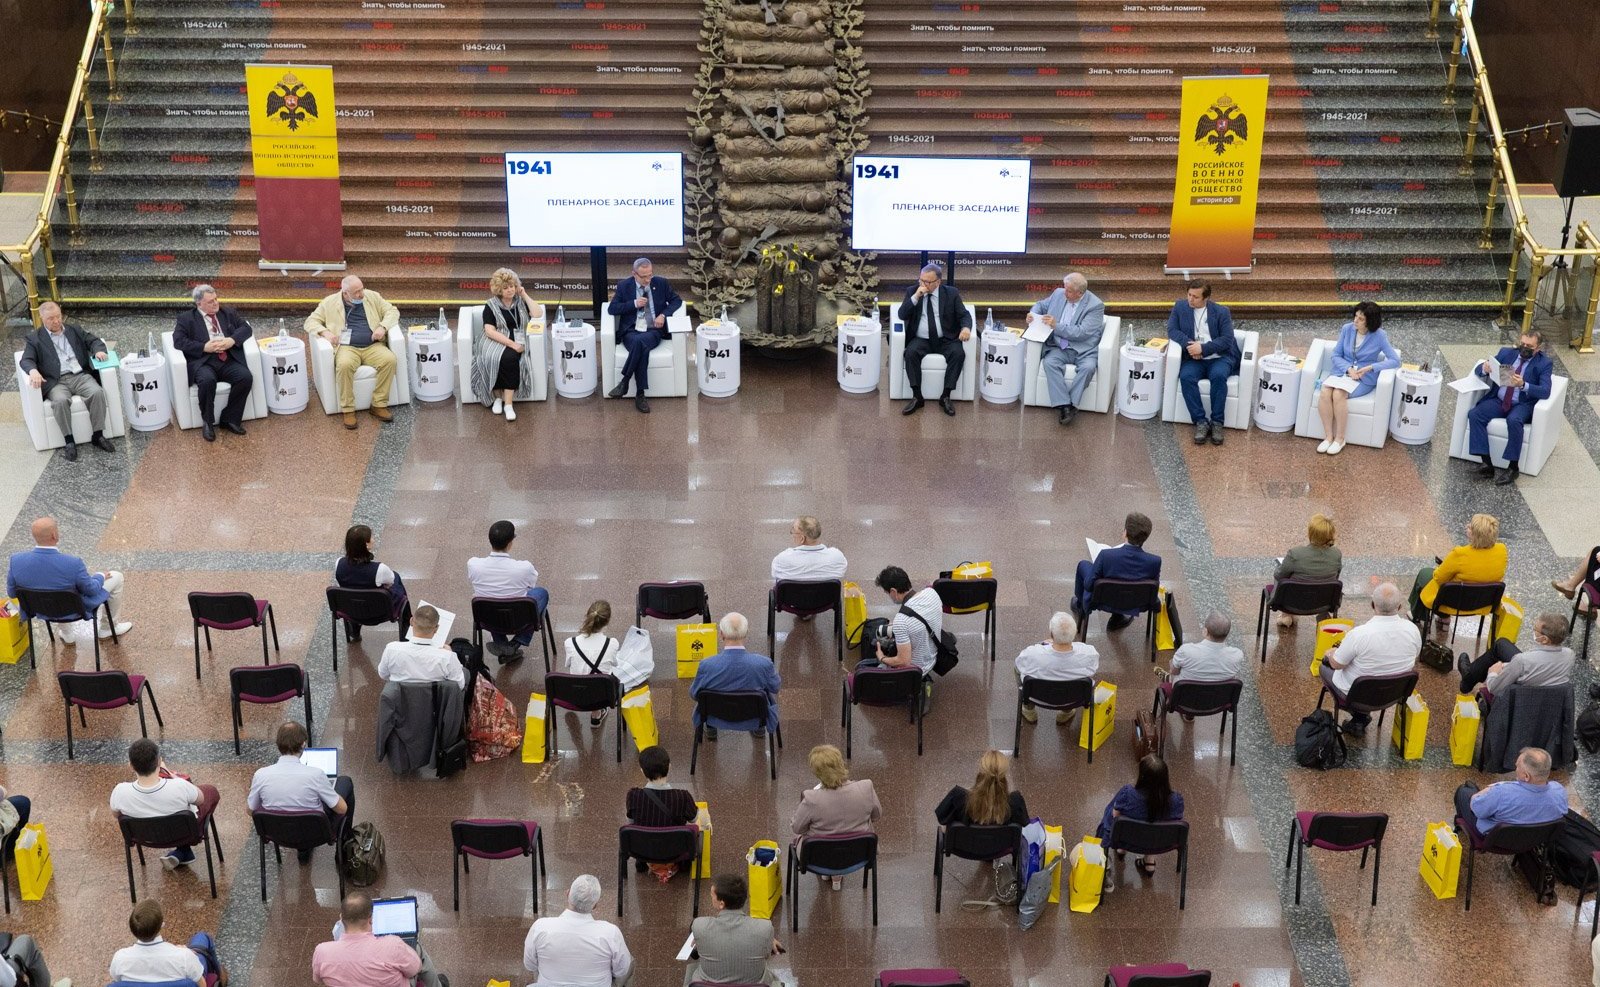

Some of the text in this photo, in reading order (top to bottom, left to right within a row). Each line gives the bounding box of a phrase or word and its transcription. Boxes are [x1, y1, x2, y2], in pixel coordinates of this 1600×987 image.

[362, 2, 386, 10] Знать,
[183, 20, 228, 28] 1945-2021
[222, 42, 246, 50] Знать,
[1088, 68, 1113, 76] Знать,
[166, 109, 192, 117] Знать,
[508, 160, 552, 174] 1941
[1193, 161, 1244, 169] РОССИЙСКОЕ
[856, 164, 899, 178] 1941
[1192, 169, 1244, 178] ВОЕННО
[1191, 186, 1242, 195] ОБЩЕСТВО
[548, 198, 675, 208] ПЛЕНАРНОЕ ЗАСЕДАНИЕ
[1196, 196, 1234, 205] история.рф
[892, 203, 955, 212] ПЛЕНАРНОЕ
[958, 204, 1020, 213] ЗАСЕДАНИЕ
[205, 228, 232, 237] Знать,
[406, 230, 432, 239] Знать,
[1101, 232, 1128, 240] Знать,
[534, 282, 561, 291] Знать,
[563, 282, 590, 290] чтобы
[704, 348, 730, 358] 1941
[842, 343, 867, 354] 1941
[416, 352, 442, 362] 1941
[560, 349, 586, 360] 1941
[984, 352, 1008, 364] 1941
[272, 364, 299, 375] 1941
[1128, 369, 1155, 380] 1941
[130, 380, 158, 392] 1941
[1259, 378, 1283, 392] 1941
[1401, 392, 1428, 404] 1941
